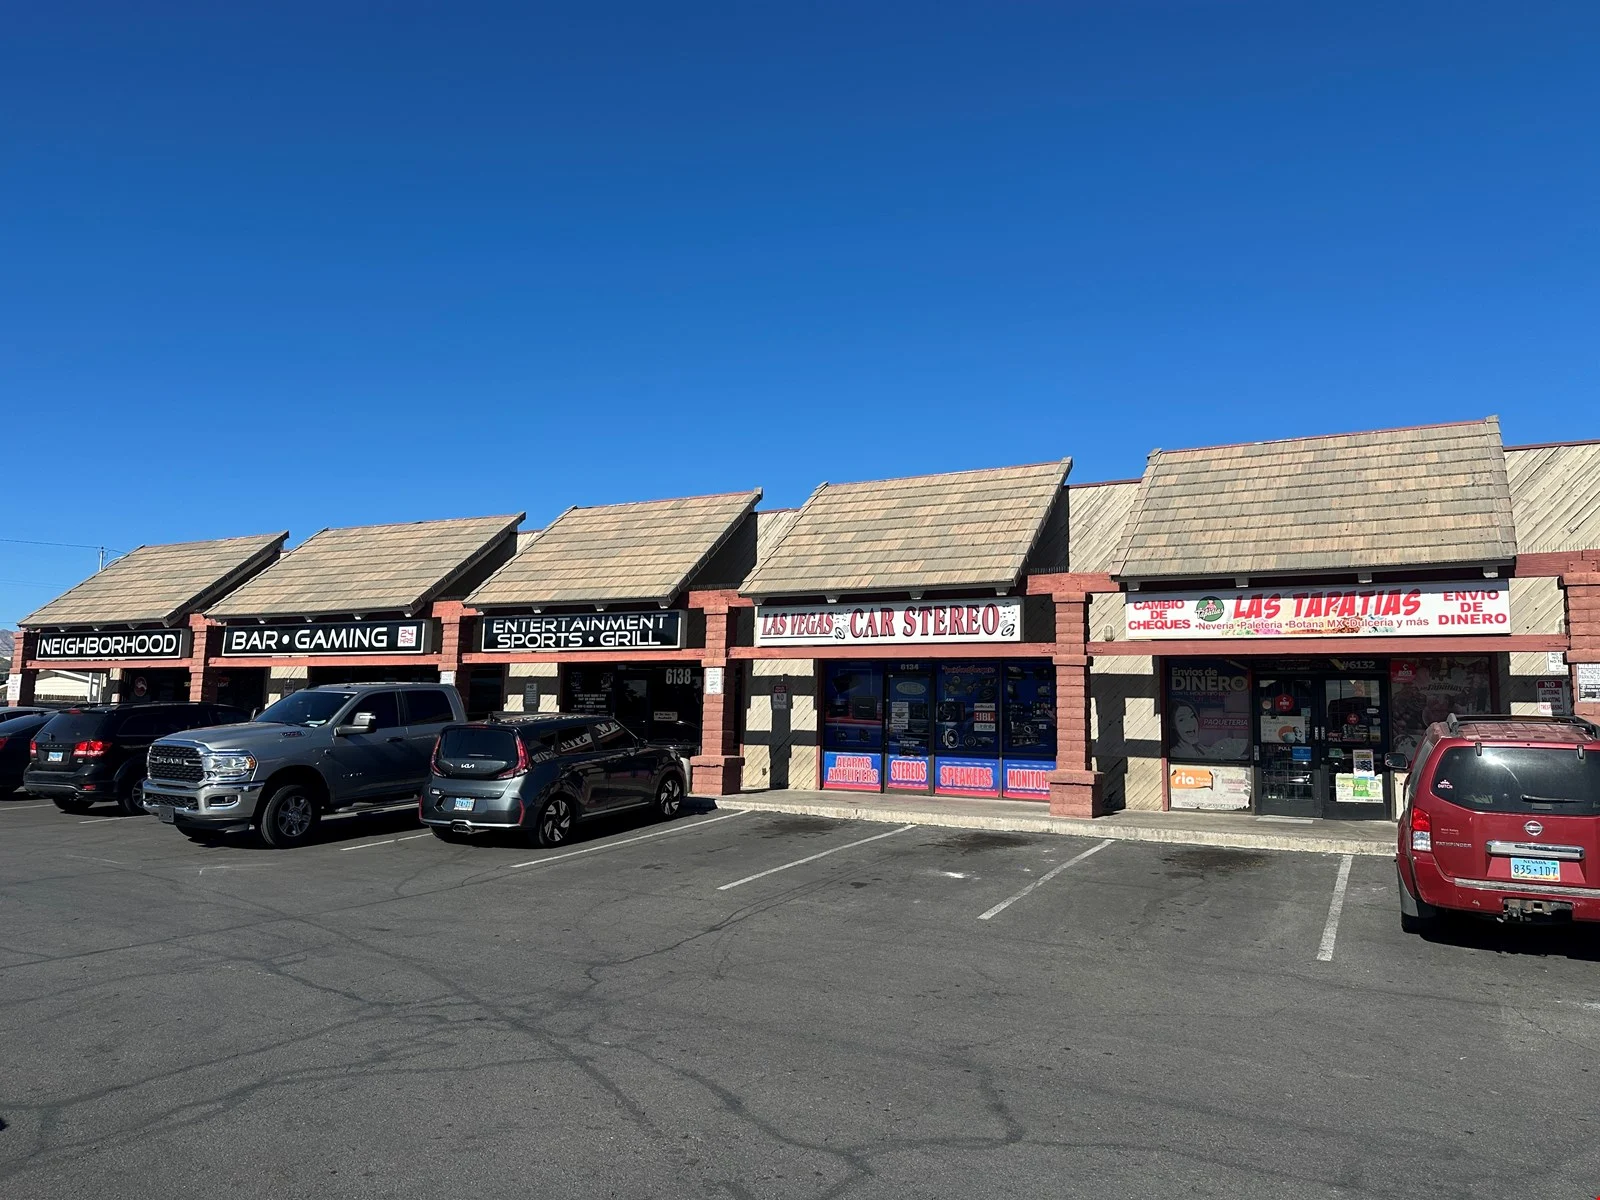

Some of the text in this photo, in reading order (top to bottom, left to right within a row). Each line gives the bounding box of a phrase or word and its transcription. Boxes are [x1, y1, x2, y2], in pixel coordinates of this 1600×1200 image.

[1443, 589, 1499, 602] ENVIO
[1133, 600, 1185, 611] CAMBIO
[1232, 588, 1421, 620] LAS TAPATIAS
[1460, 602, 1483, 612] DE
[849, 602, 1000, 638] CAR STEREO
[1150, 610, 1168, 620] DE
[1396, 619, 1403, 628] y
[1405, 617, 1430, 626] más
[1438, 613, 1507, 625] DINERO
[492, 614, 669, 634] ENTERTAINMENT
[761, 610, 835, 636] LAS VEGAS
[1128, 619, 1191, 630] CHEQUES
[231, 627, 388, 650] BAR GAMING
[400, 629, 414, 637] 24
[497, 630, 661, 649] SPORTS GRILL
[40, 634, 177, 655] NEIGHBORHOOD
[666, 668, 692, 685] 6138
[1205, 667, 1218, 676] de
[1171, 676, 1248, 691] DINERO
[836, 756, 871, 769] ALARMS
[828, 767, 878, 783] AMPLIFIERS
[891, 760, 927, 781] STEREOS
[940, 766, 993, 787] SPEAKERS
[1174, 771, 1195, 785] ria
